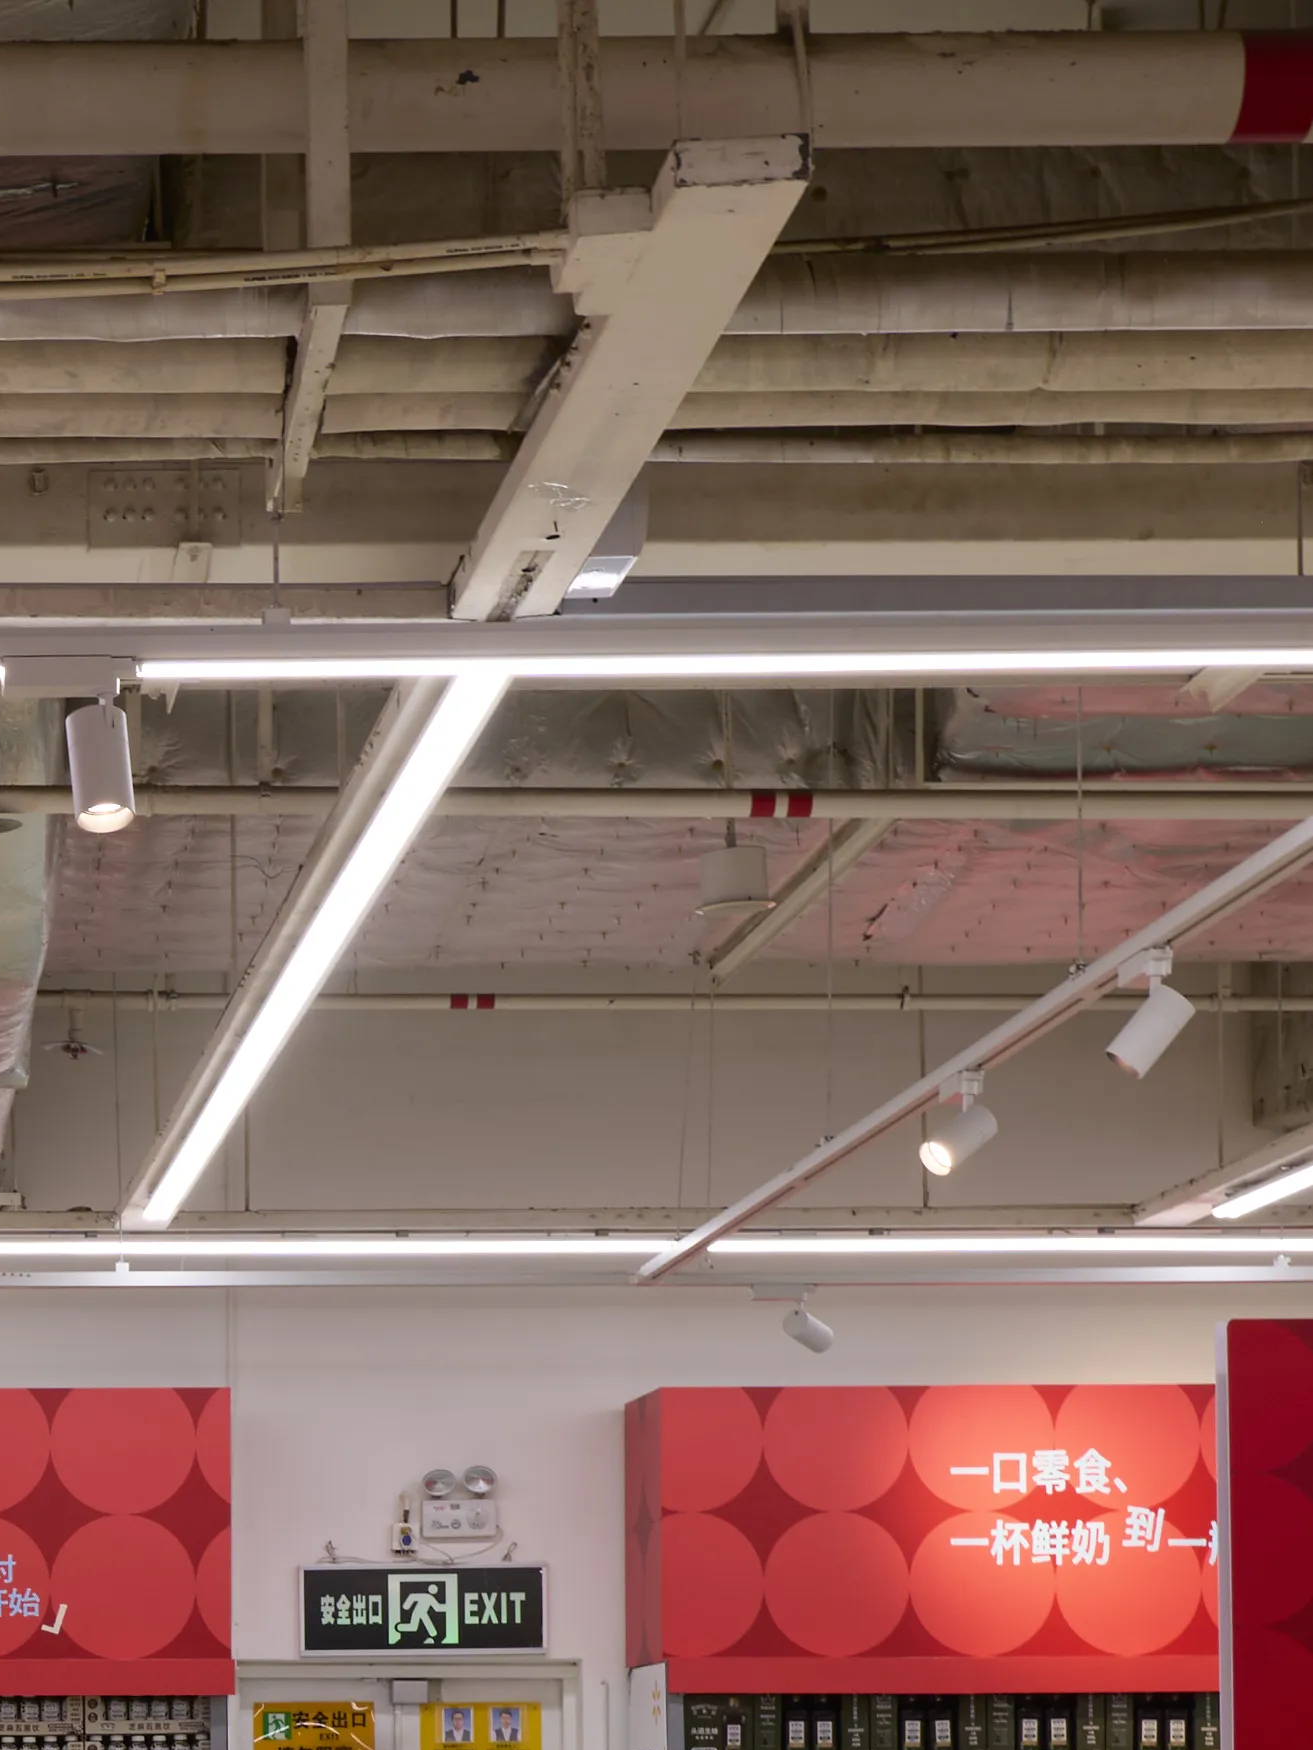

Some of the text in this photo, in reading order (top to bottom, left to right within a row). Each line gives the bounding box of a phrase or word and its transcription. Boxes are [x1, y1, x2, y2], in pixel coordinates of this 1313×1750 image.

[950, 1448, 1127, 1495] 一口零食、
[320, 1594, 383, 1626] 安全出口
[464, 1592, 526, 1625] EXIT
[293, 1711, 366, 1729] 安全出口
